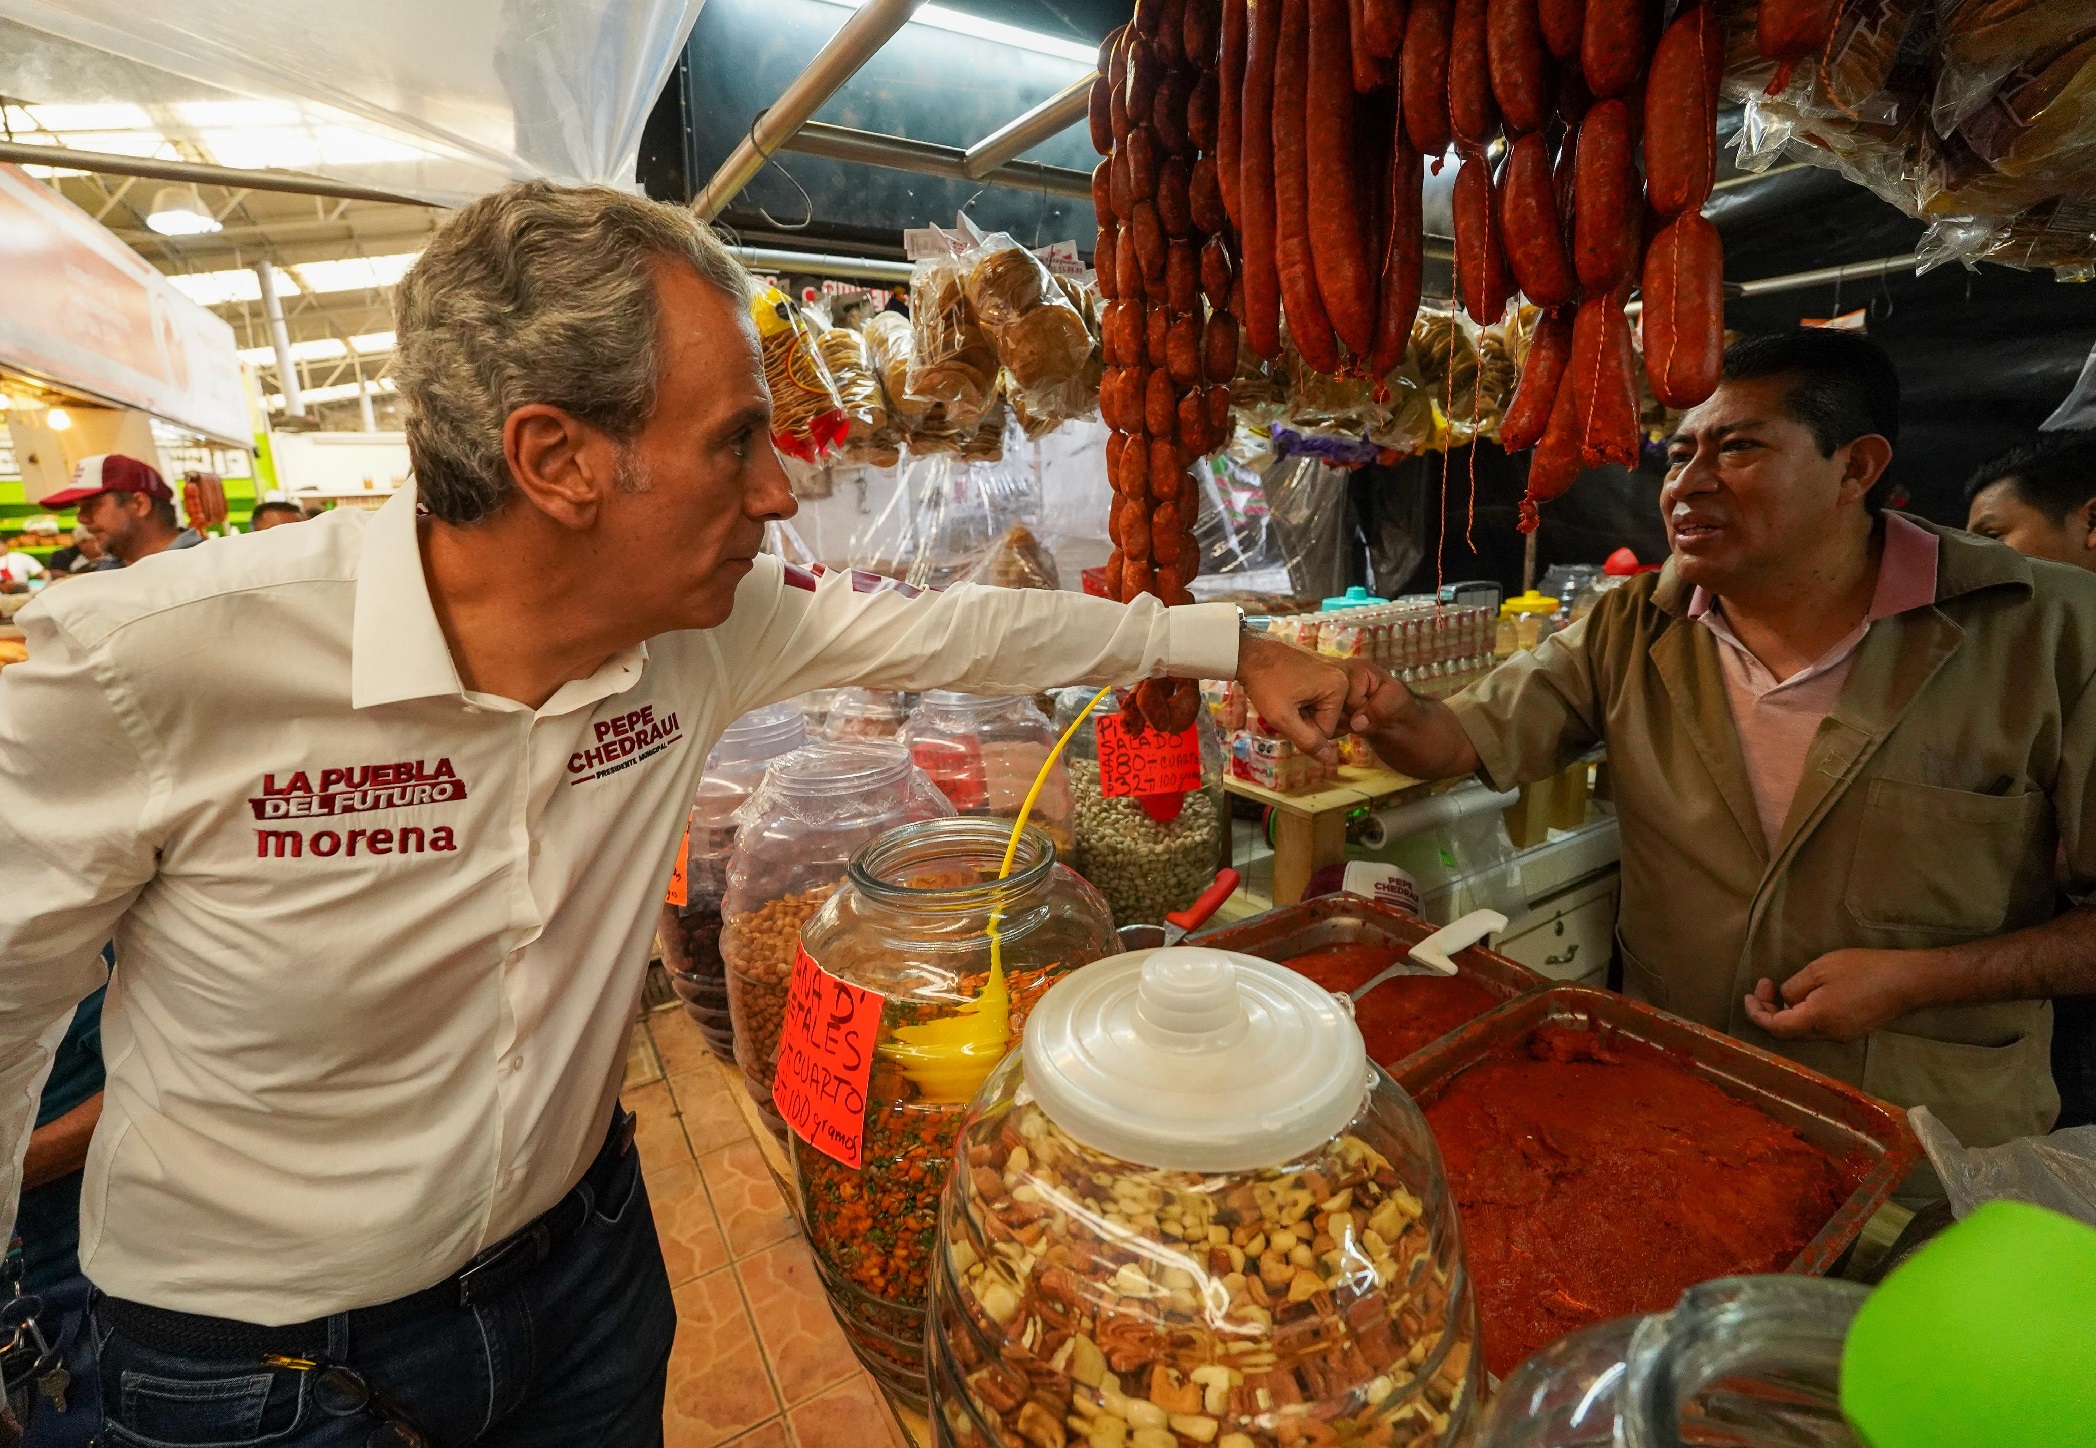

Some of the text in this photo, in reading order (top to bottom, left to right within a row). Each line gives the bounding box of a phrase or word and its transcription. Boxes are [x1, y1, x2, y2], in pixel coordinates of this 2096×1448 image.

[594, 705, 654, 743] PEPE
[567, 712, 680, 774] CHEDRAUI
[596, 742, 668, 779] PRESIDENTE MUNICIPAL
[1101, 733, 1183, 756] SALADO
[262, 758, 457, 797] LA PUEBLA
[264, 783, 454, 819] DEL FUTURO
[256, 823, 458, 859] morena
[1388, 876, 1412, 890] PEPE
[793, 1050, 864, 1115] CUARTO
[810, 1112, 859, 1160] gramos
